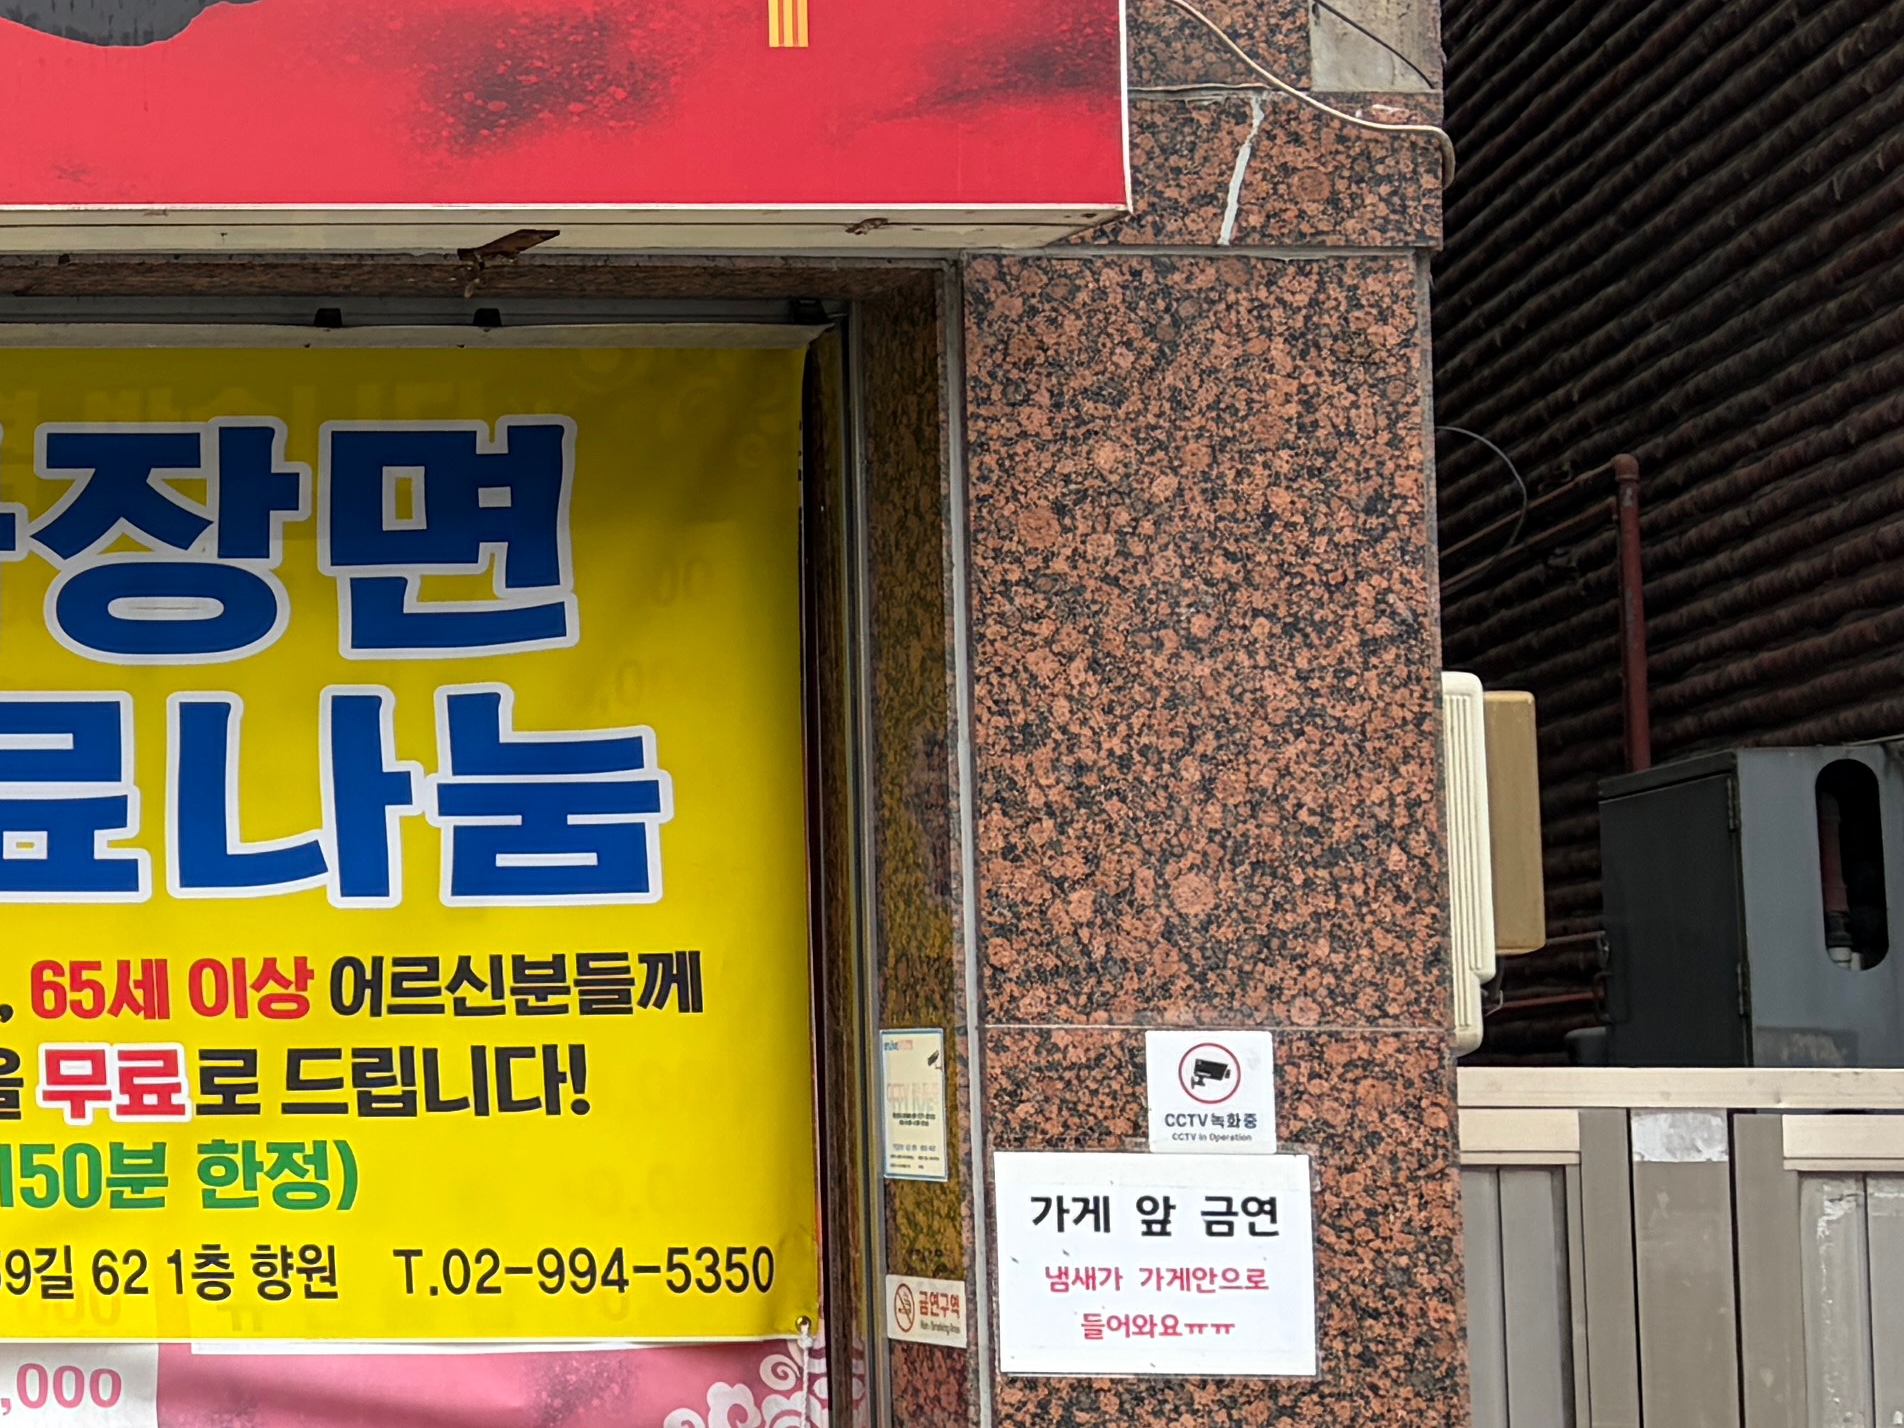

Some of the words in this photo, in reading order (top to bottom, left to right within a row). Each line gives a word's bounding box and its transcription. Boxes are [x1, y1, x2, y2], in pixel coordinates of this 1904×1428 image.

[30, 957, 169, 1021] 65세
[187, 956, 314, 1022] 이상
[328, 952, 705, 1020] 어르신분들께
[37, 1042, 263, 1125] 무료로
[281, 1045, 590, 1121] 드립니다!
[1164, 1113, 1209, 1128] CCTV
[1210, 1112, 1258, 1129] 녹화중
[1171, 1132, 1197, 1141] CCTV
[1208, 1132, 1253, 1143] Operation
[197, 1140, 358, 1214] 한정)
[1030, 1195, 1112, 1235] 가게
[1136, 1194, 1177, 1237] 앞
[1200, 1195, 1281, 1238] 금연
[91, 1247, 150, 1299] 62
[167, 1245, 235, 1303] 1층
[250, 1243, 340, 1302] 향원
[394, 1246, 775, 1299] T.02-994-5350
[1045, 1265, 1123, 1294] 냄새가
[1139, 1265, 1270, 1294] 가게안으로
[918, 1290, 961, 1320] 금연구역
[1080, 1312, 1236, 1341] 들어와요ㅠㅠ
